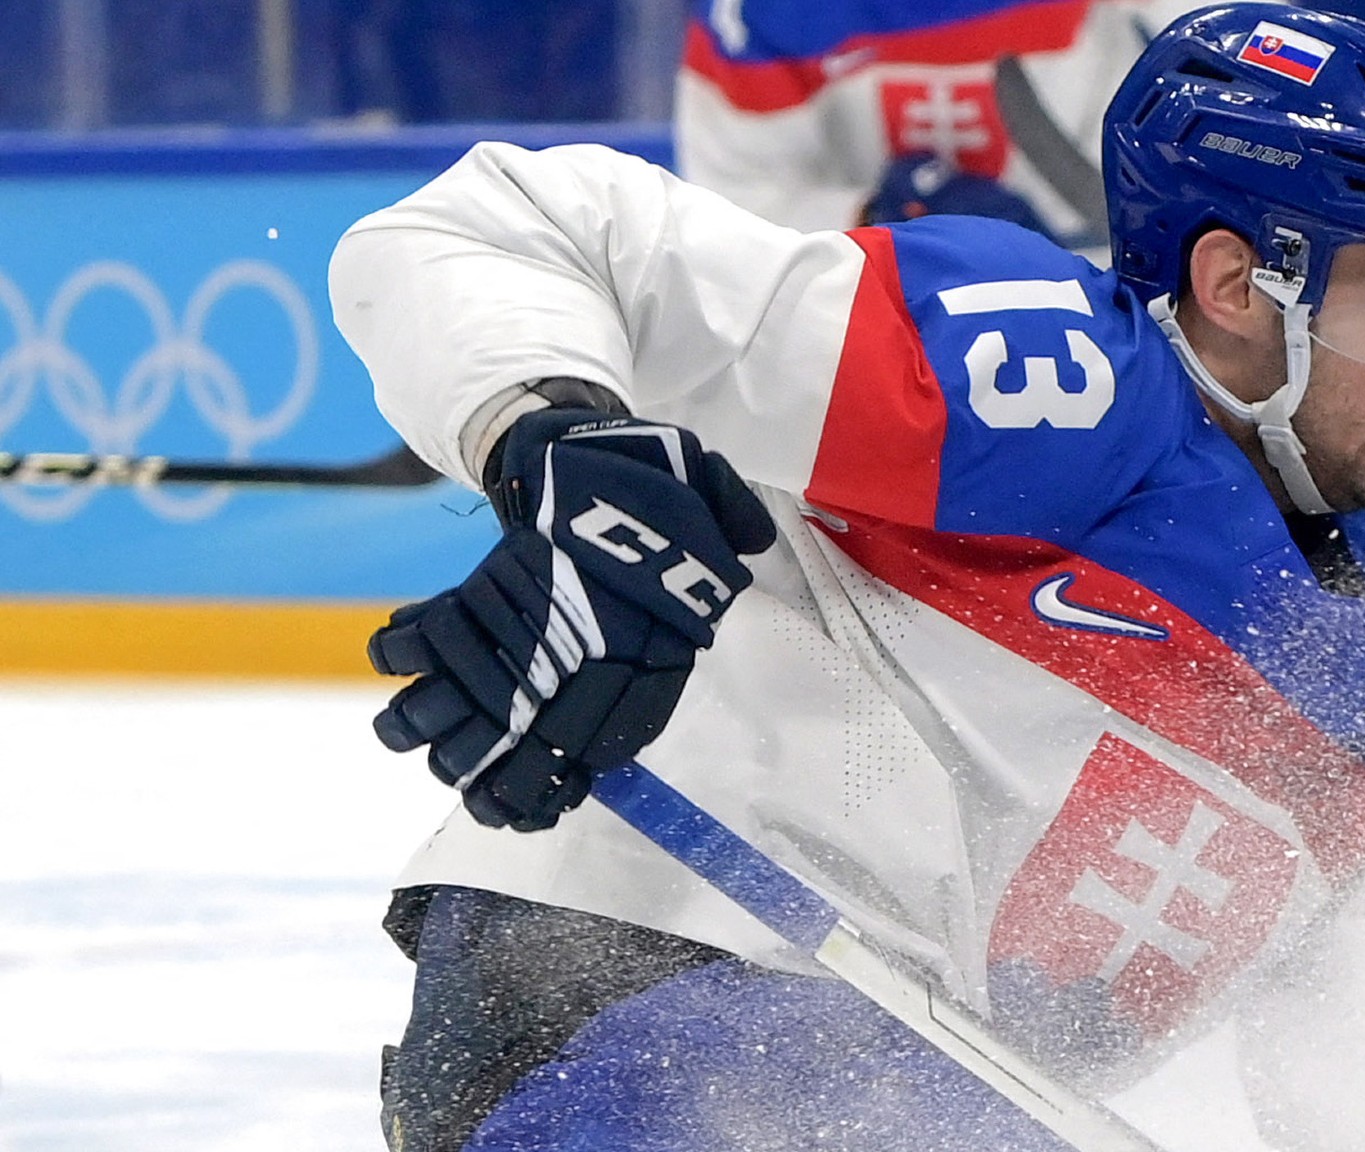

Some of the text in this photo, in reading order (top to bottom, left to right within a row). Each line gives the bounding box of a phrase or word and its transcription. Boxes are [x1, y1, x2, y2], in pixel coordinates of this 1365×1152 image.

[1200, 132, 1302, 169] BAUER
[937, 278, 1116, 429] 13
[569, 496, 733, 632] CC
